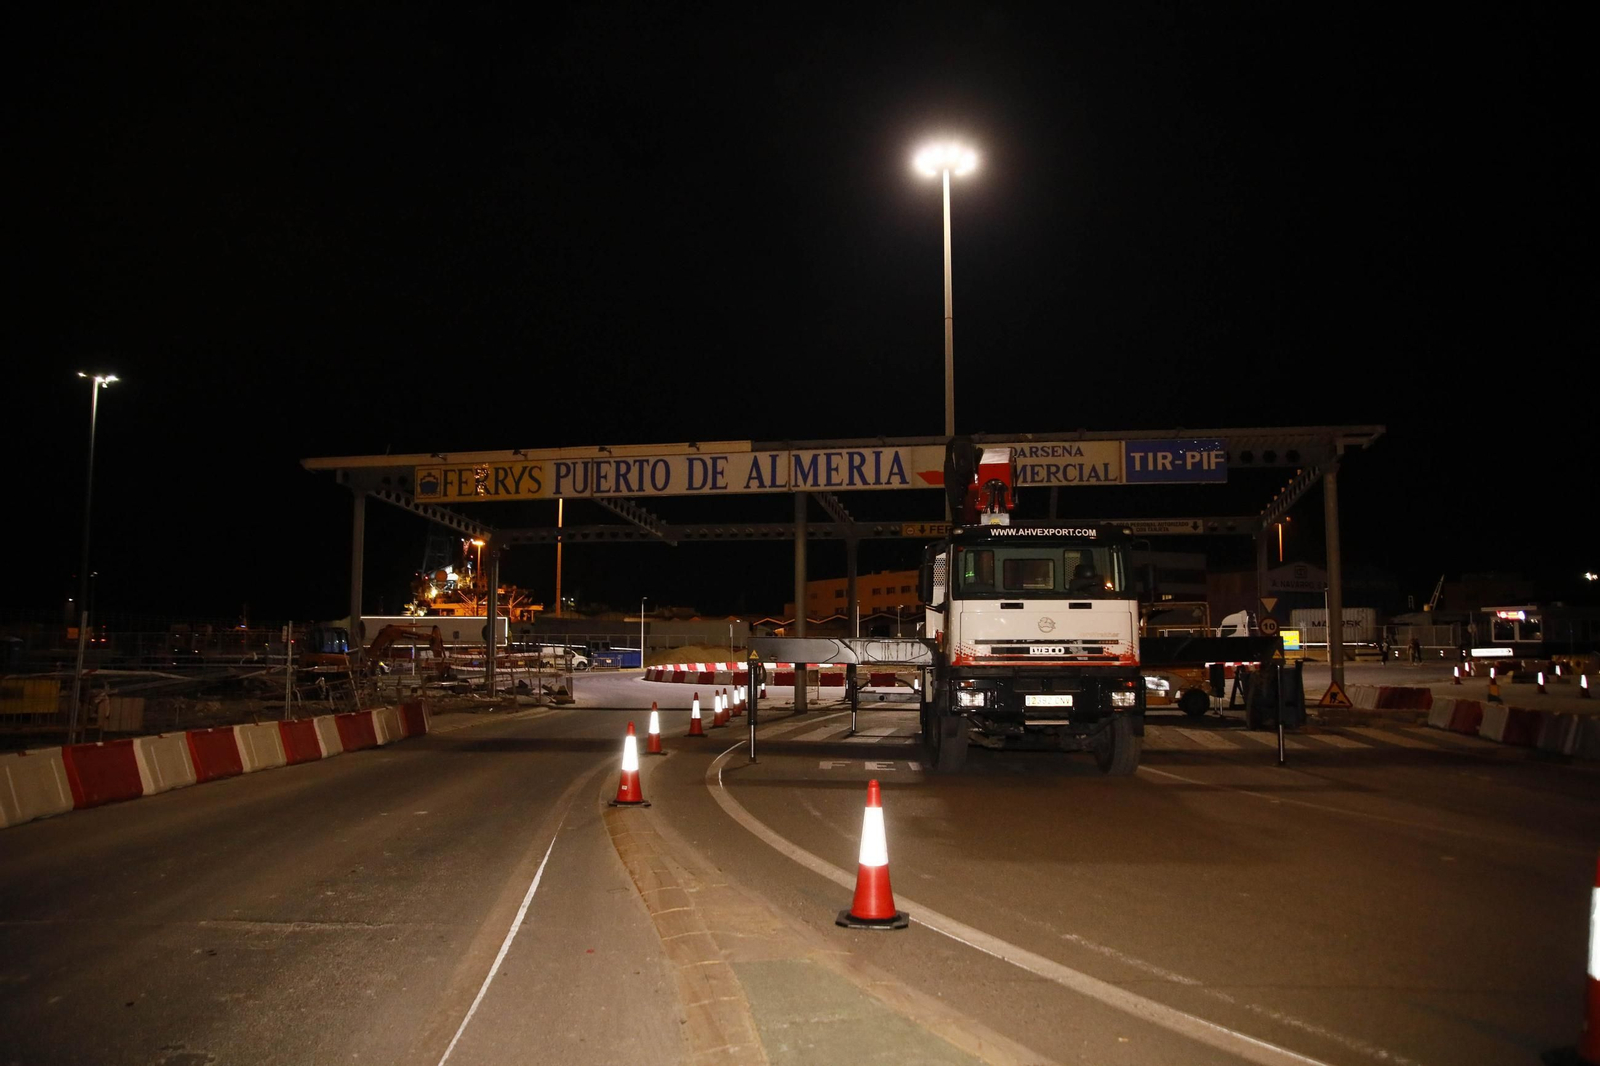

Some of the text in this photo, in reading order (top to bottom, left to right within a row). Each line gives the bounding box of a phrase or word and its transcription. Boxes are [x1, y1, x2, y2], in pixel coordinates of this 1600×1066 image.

[1130, 451, 1224, 471] TIR-PIF
[443, 465, 542, 497] FERRYS
[553, 451, 909, 495] PUERTO DE ALMERIA
[990, 528, 1097, 537] WWW.AHVEXPORT.COM
[1263, 622, 1275, 630] 10
